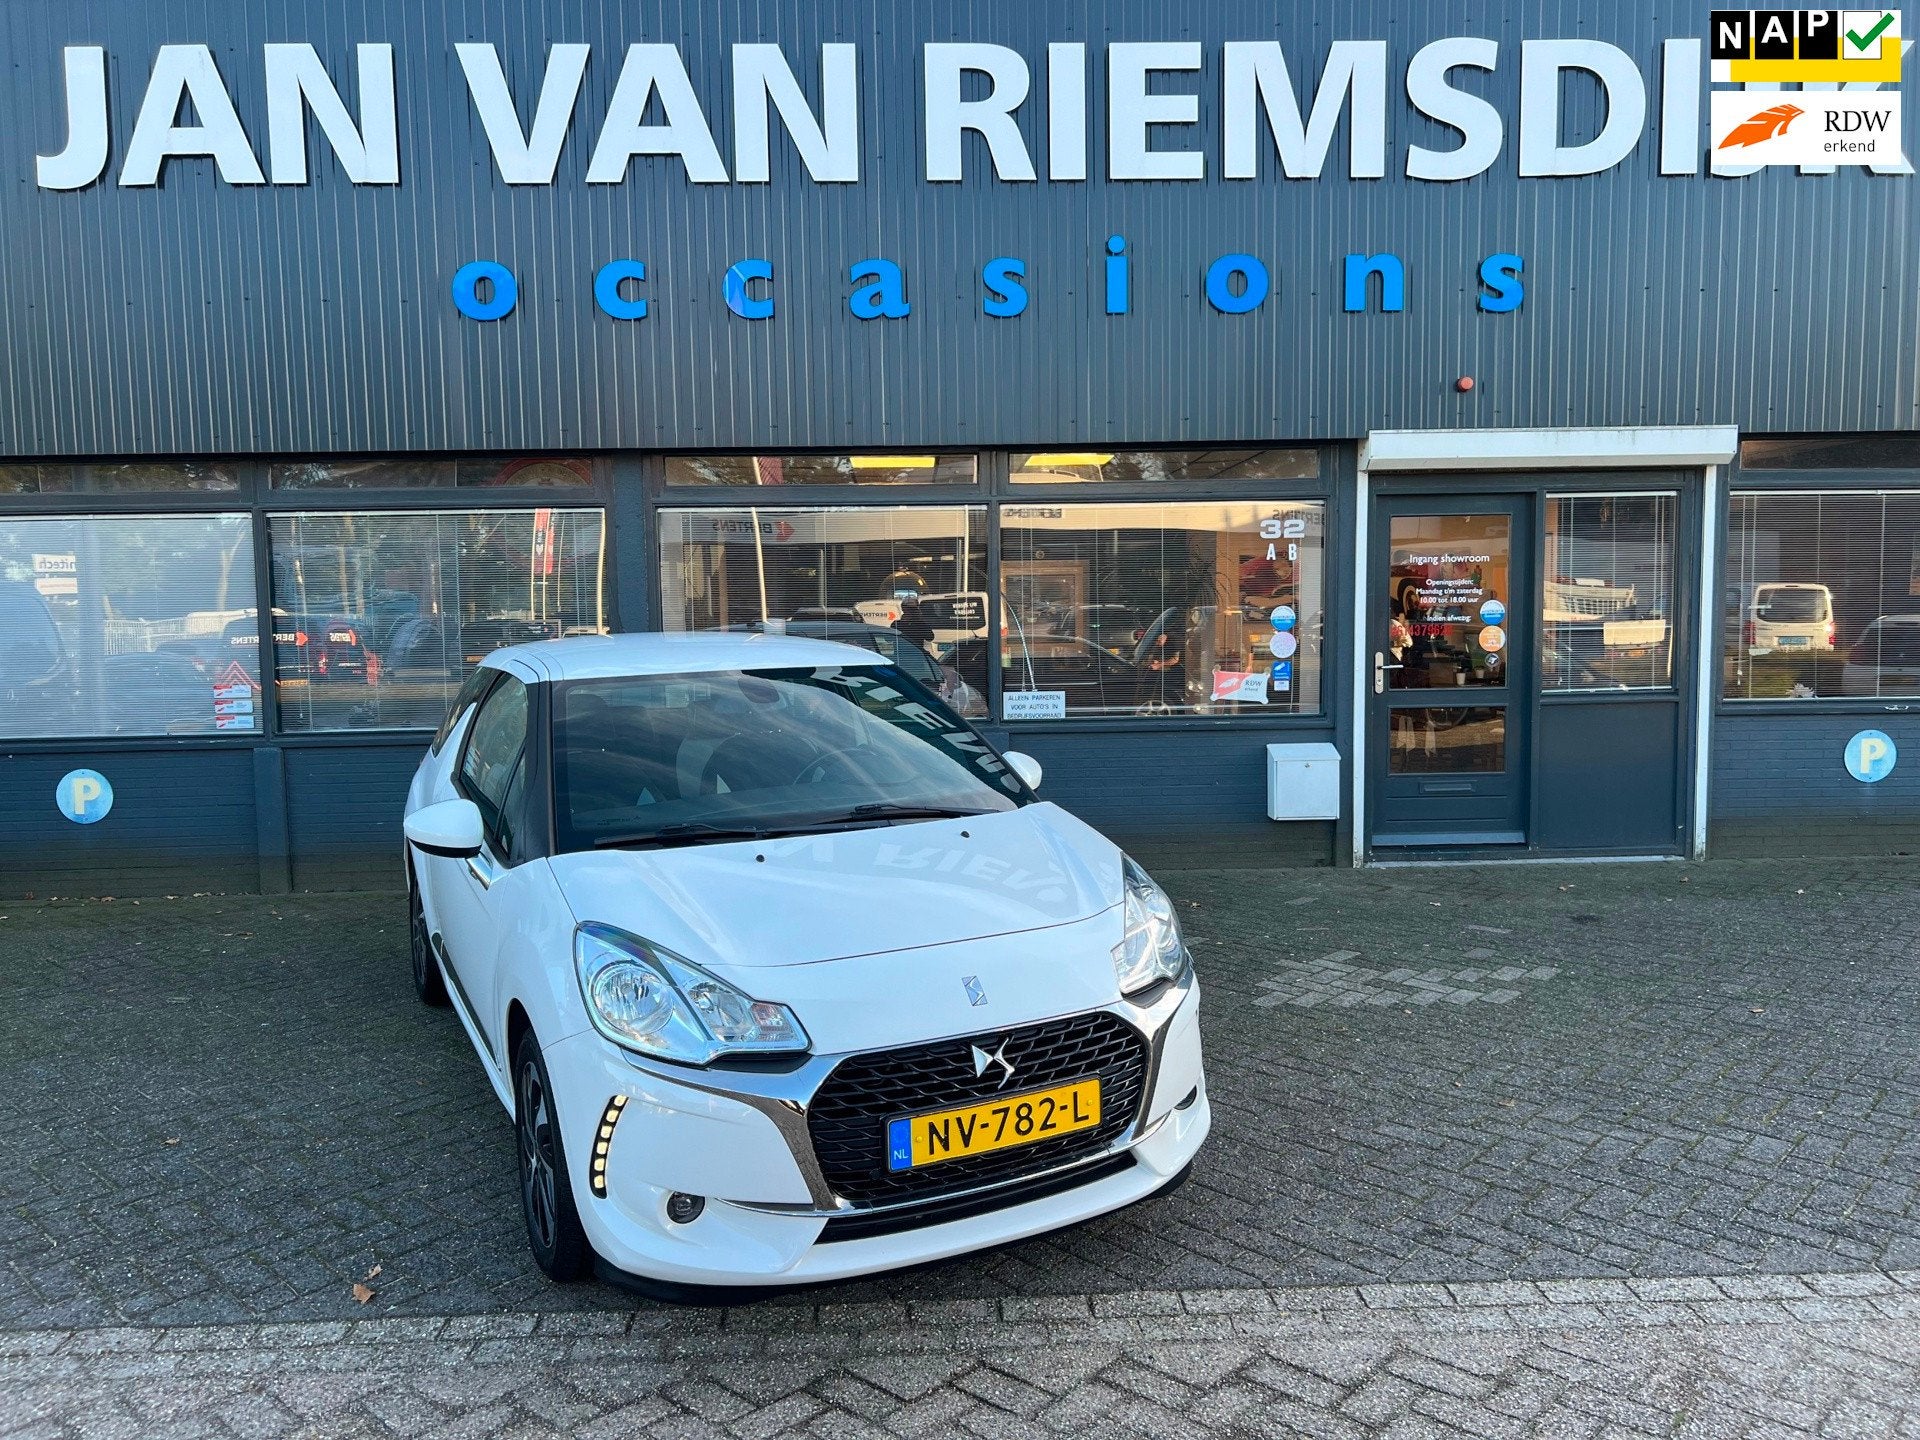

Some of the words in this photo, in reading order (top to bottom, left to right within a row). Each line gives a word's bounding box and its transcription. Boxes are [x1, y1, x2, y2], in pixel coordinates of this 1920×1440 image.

[36, 42, 401, 190] JAN
[453, 41, 860, 186] VAN
[923, 36, 1917, 182] RIEMSDI
[451, 234, 1526, 322] occasions
[1260, 519, 1305, 539] 32
[1266, 543, 1277, 561] A
[1288, 543, 1298, 561] B
[1409, 554, 1439, 566] Ingang
[1440, 553, 1490, 563] showroom
[1415, 587, 1443, 596] Maandag
[1456, 586, 1483, 596] zaterdag
[1010, 703, 1026, 711] VOOR
[1859, 737, 1888, 774] P
[71, 777, 102, 815] P
[927, 1090, 1090, 1157] NV-782-L
[893, 1148, 909, 1160] NL
